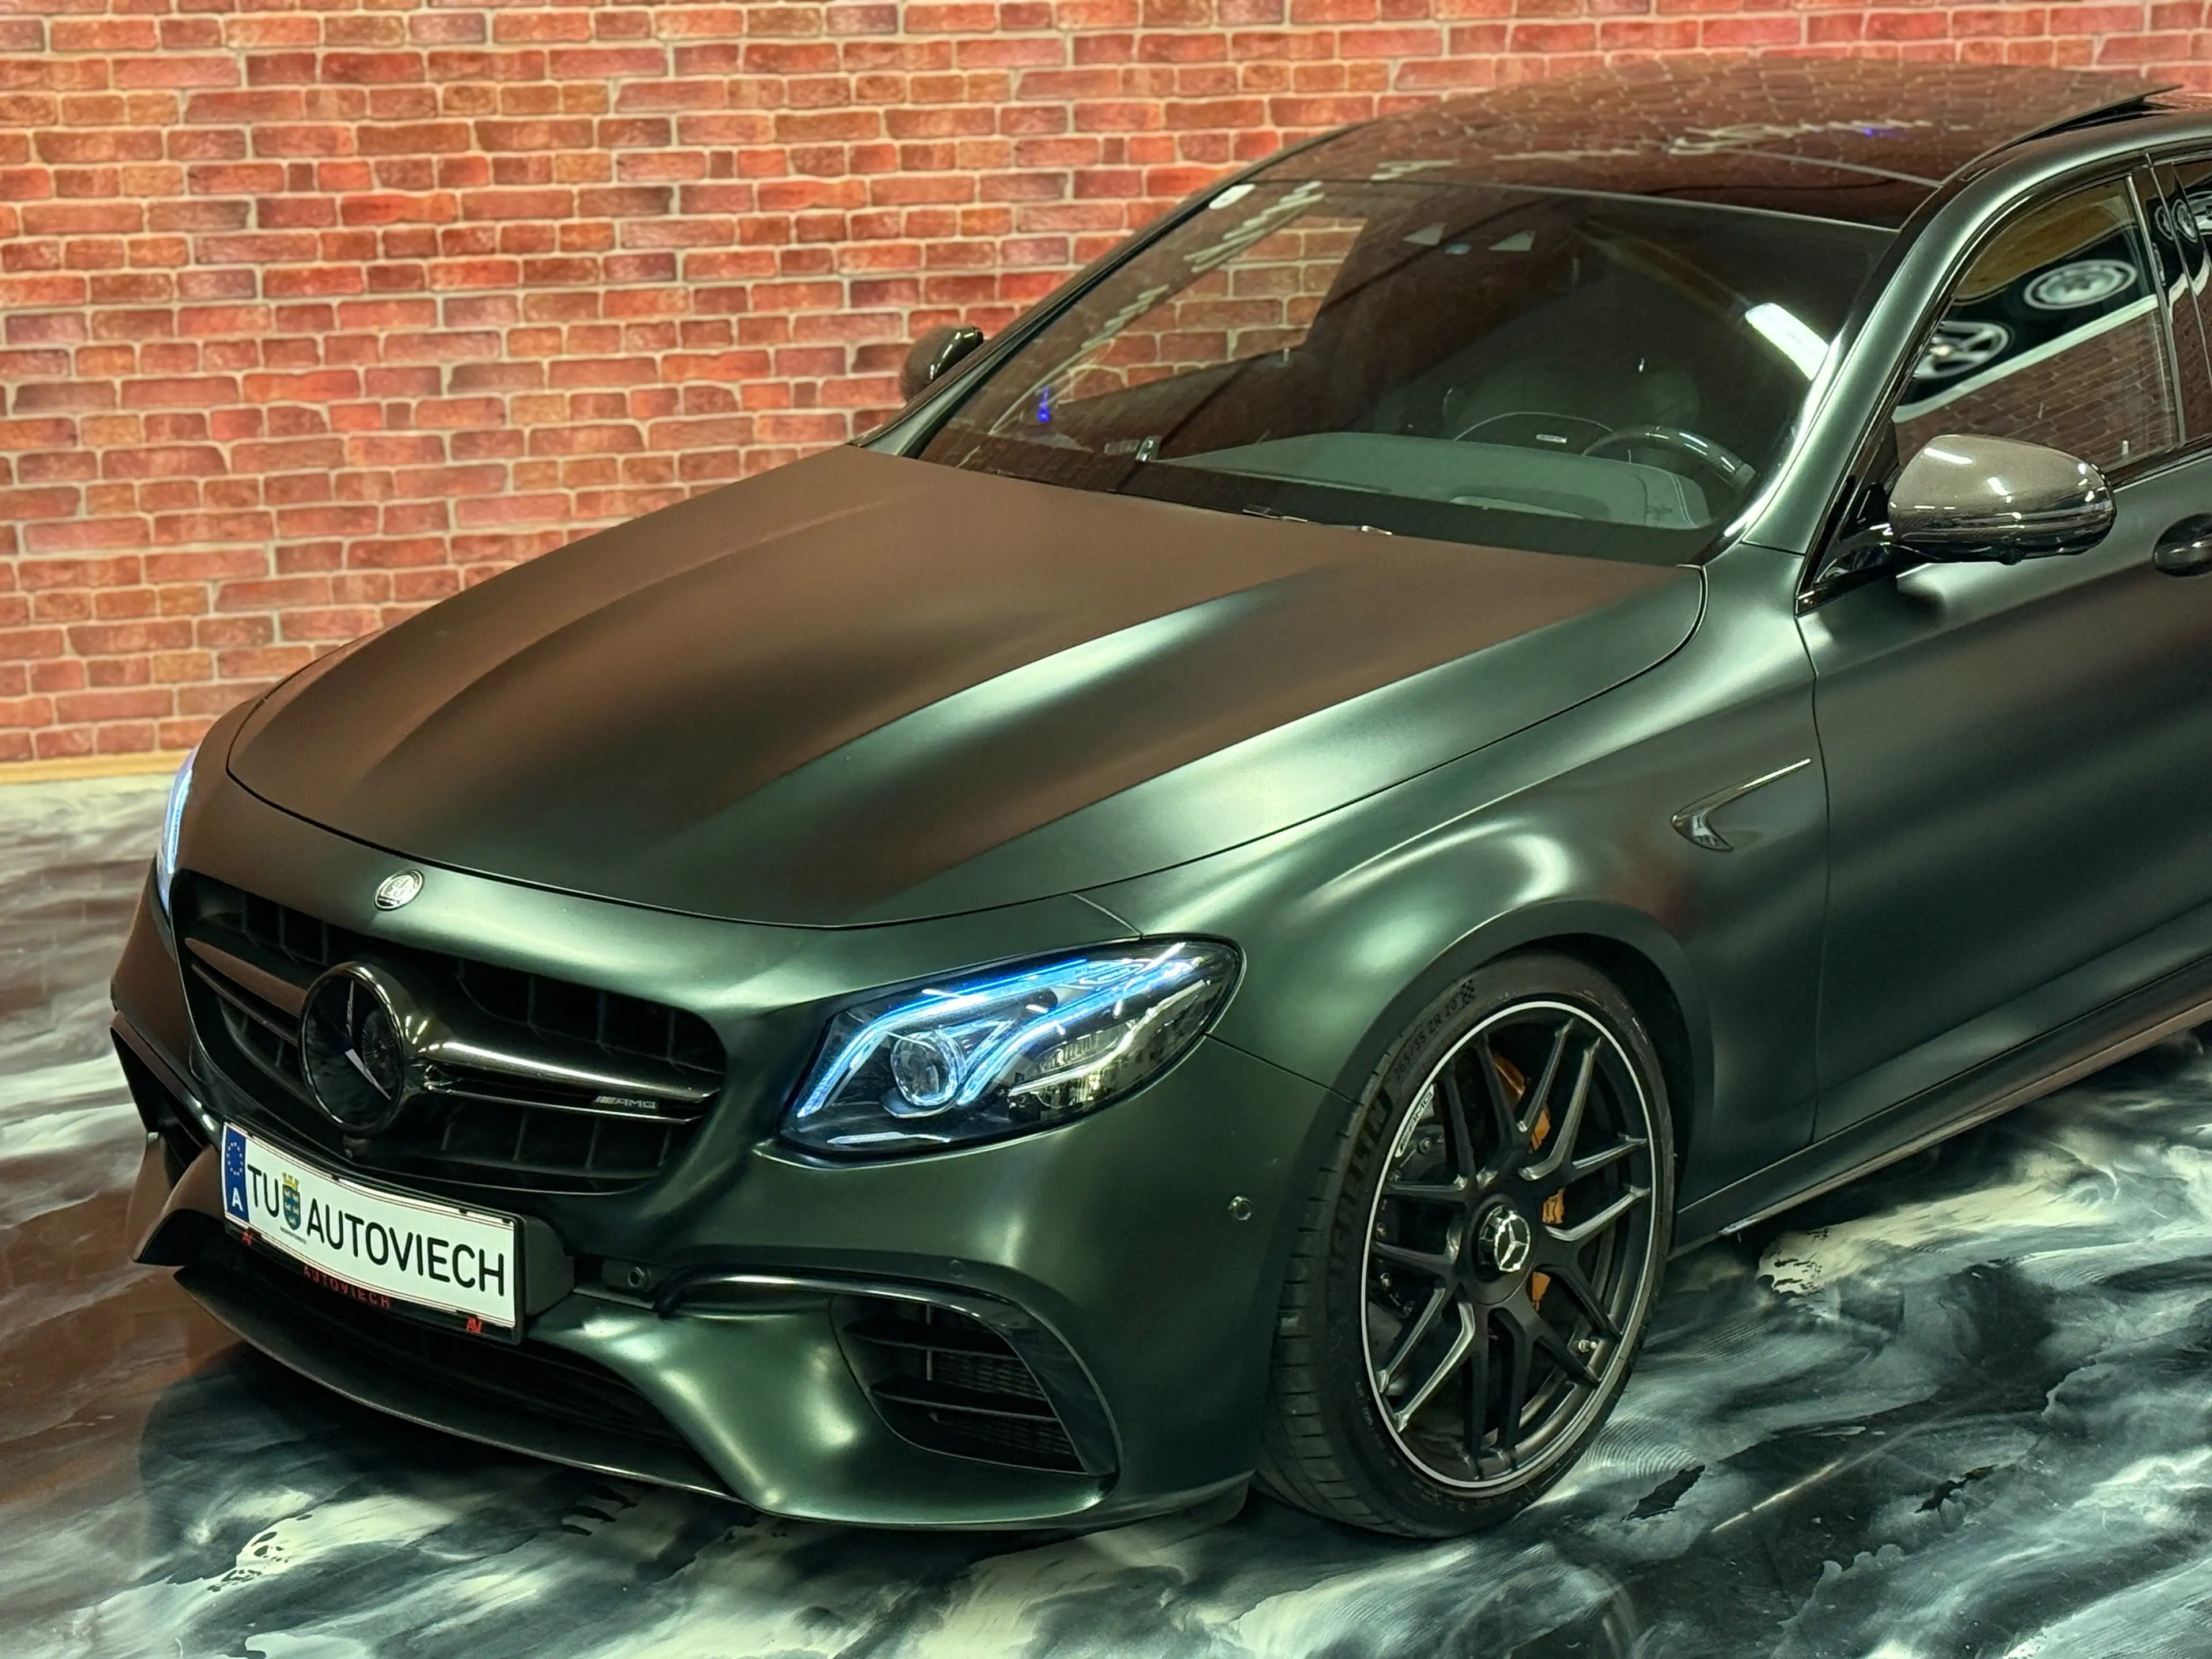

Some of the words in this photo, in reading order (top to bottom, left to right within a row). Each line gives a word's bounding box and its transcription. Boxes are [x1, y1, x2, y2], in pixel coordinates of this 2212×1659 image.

[613, 1097, 657, 1109] AMG
[231, 1186, 243, 1213] A
[247, 1164, 279, 1218] TU
[306, 1198, 505, 1297] AUTOVIECH
[302, 1265, 391, 1310] AUTOVIECH
[465, 1318, 483, 1334] AV
